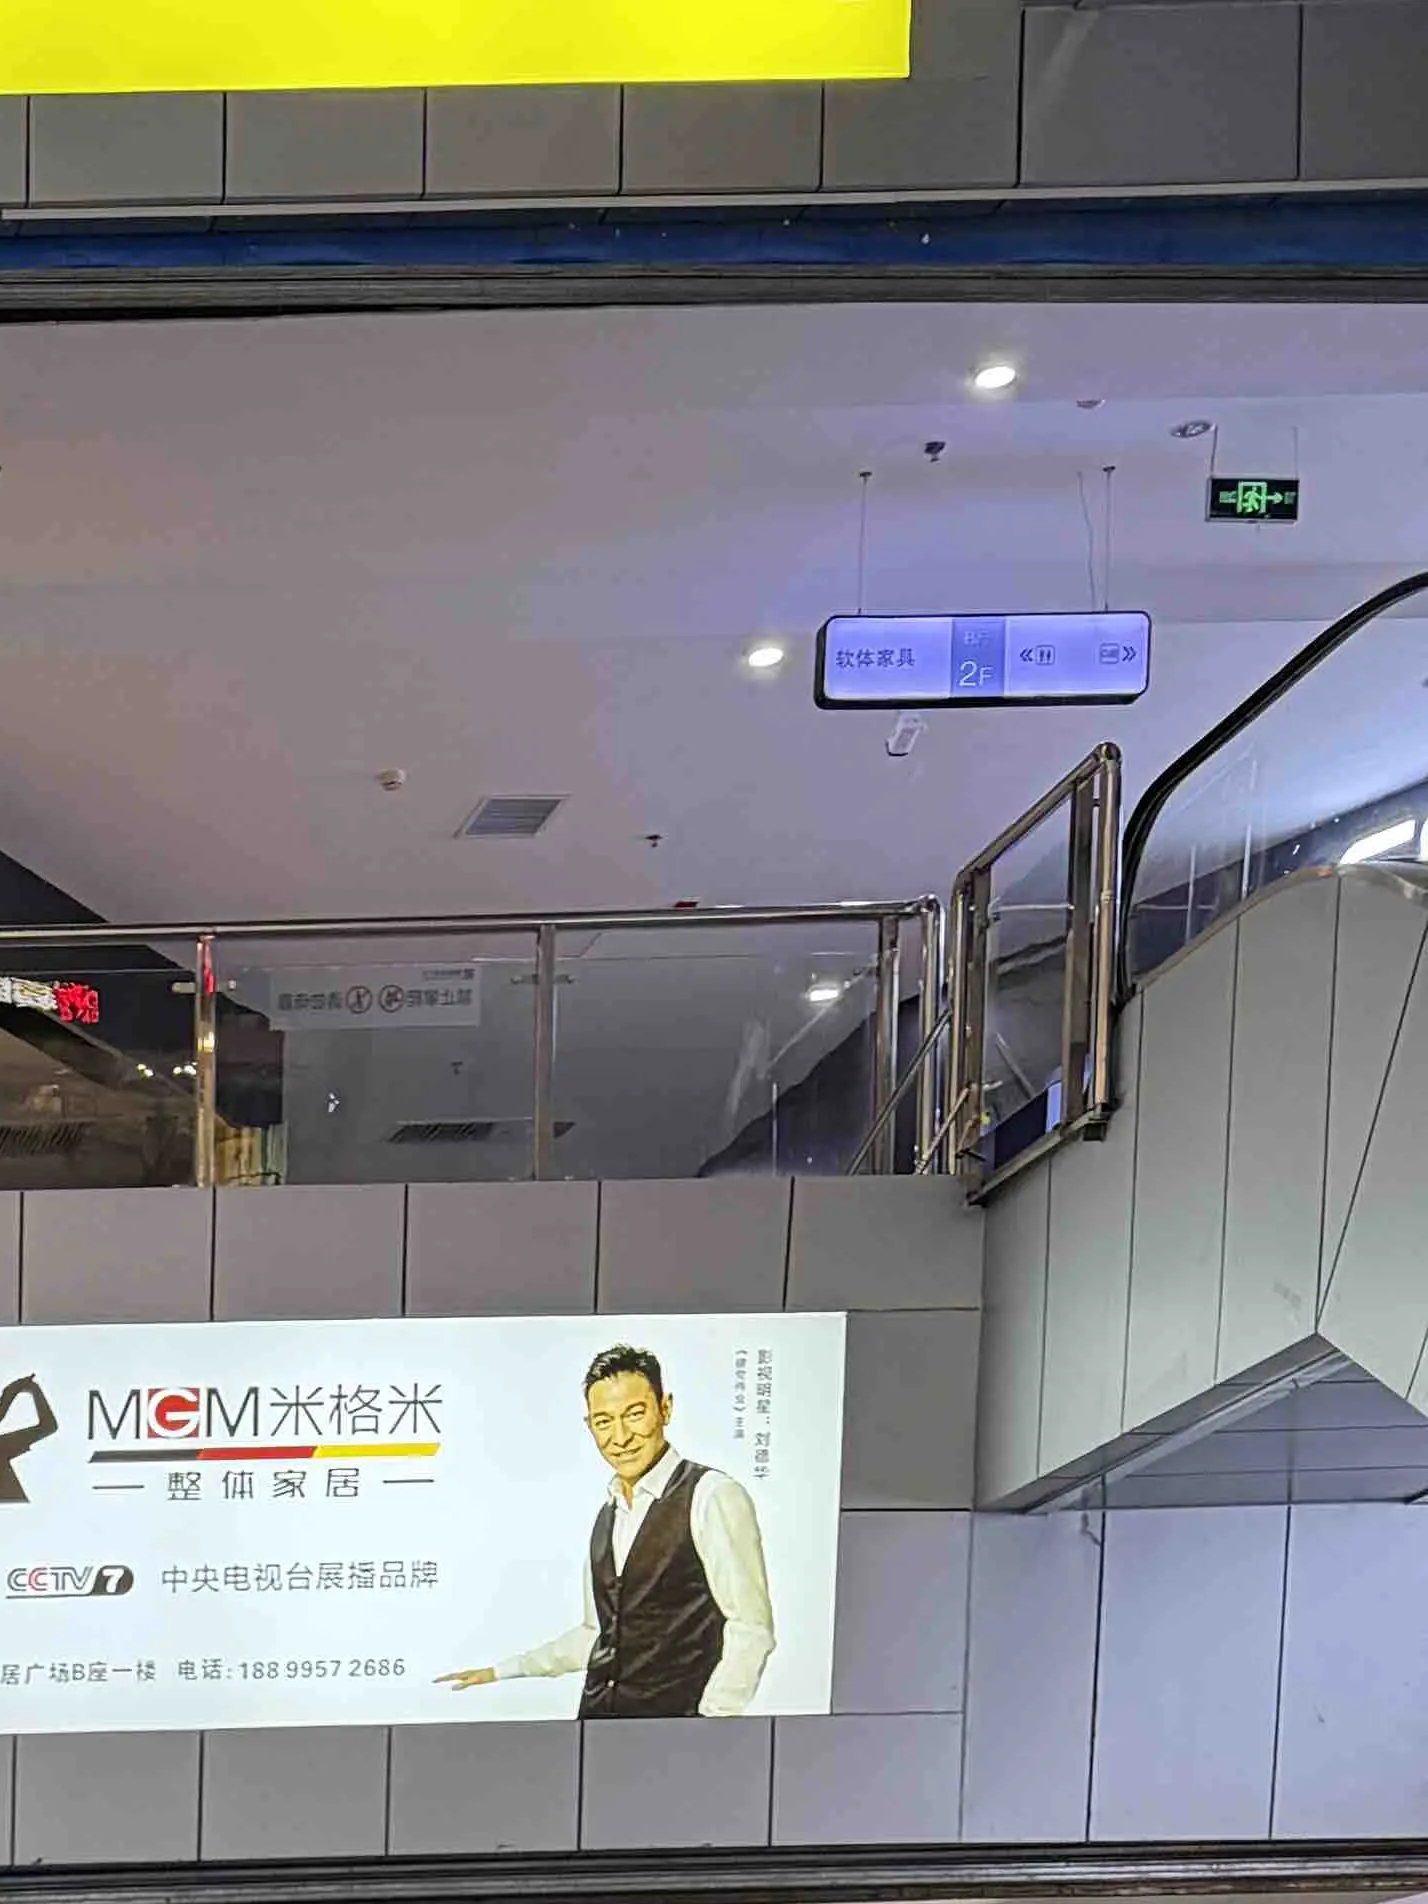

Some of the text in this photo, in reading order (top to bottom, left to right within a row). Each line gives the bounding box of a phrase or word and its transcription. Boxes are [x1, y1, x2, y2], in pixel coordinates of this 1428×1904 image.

[835, 648, 916, 669] 软体家具
[958, 659, 994, 687] 2F
[166, 1466, 360, 1502] 整体家居
[160, 1560, 440, 1594] 中央电视台展播品牌
